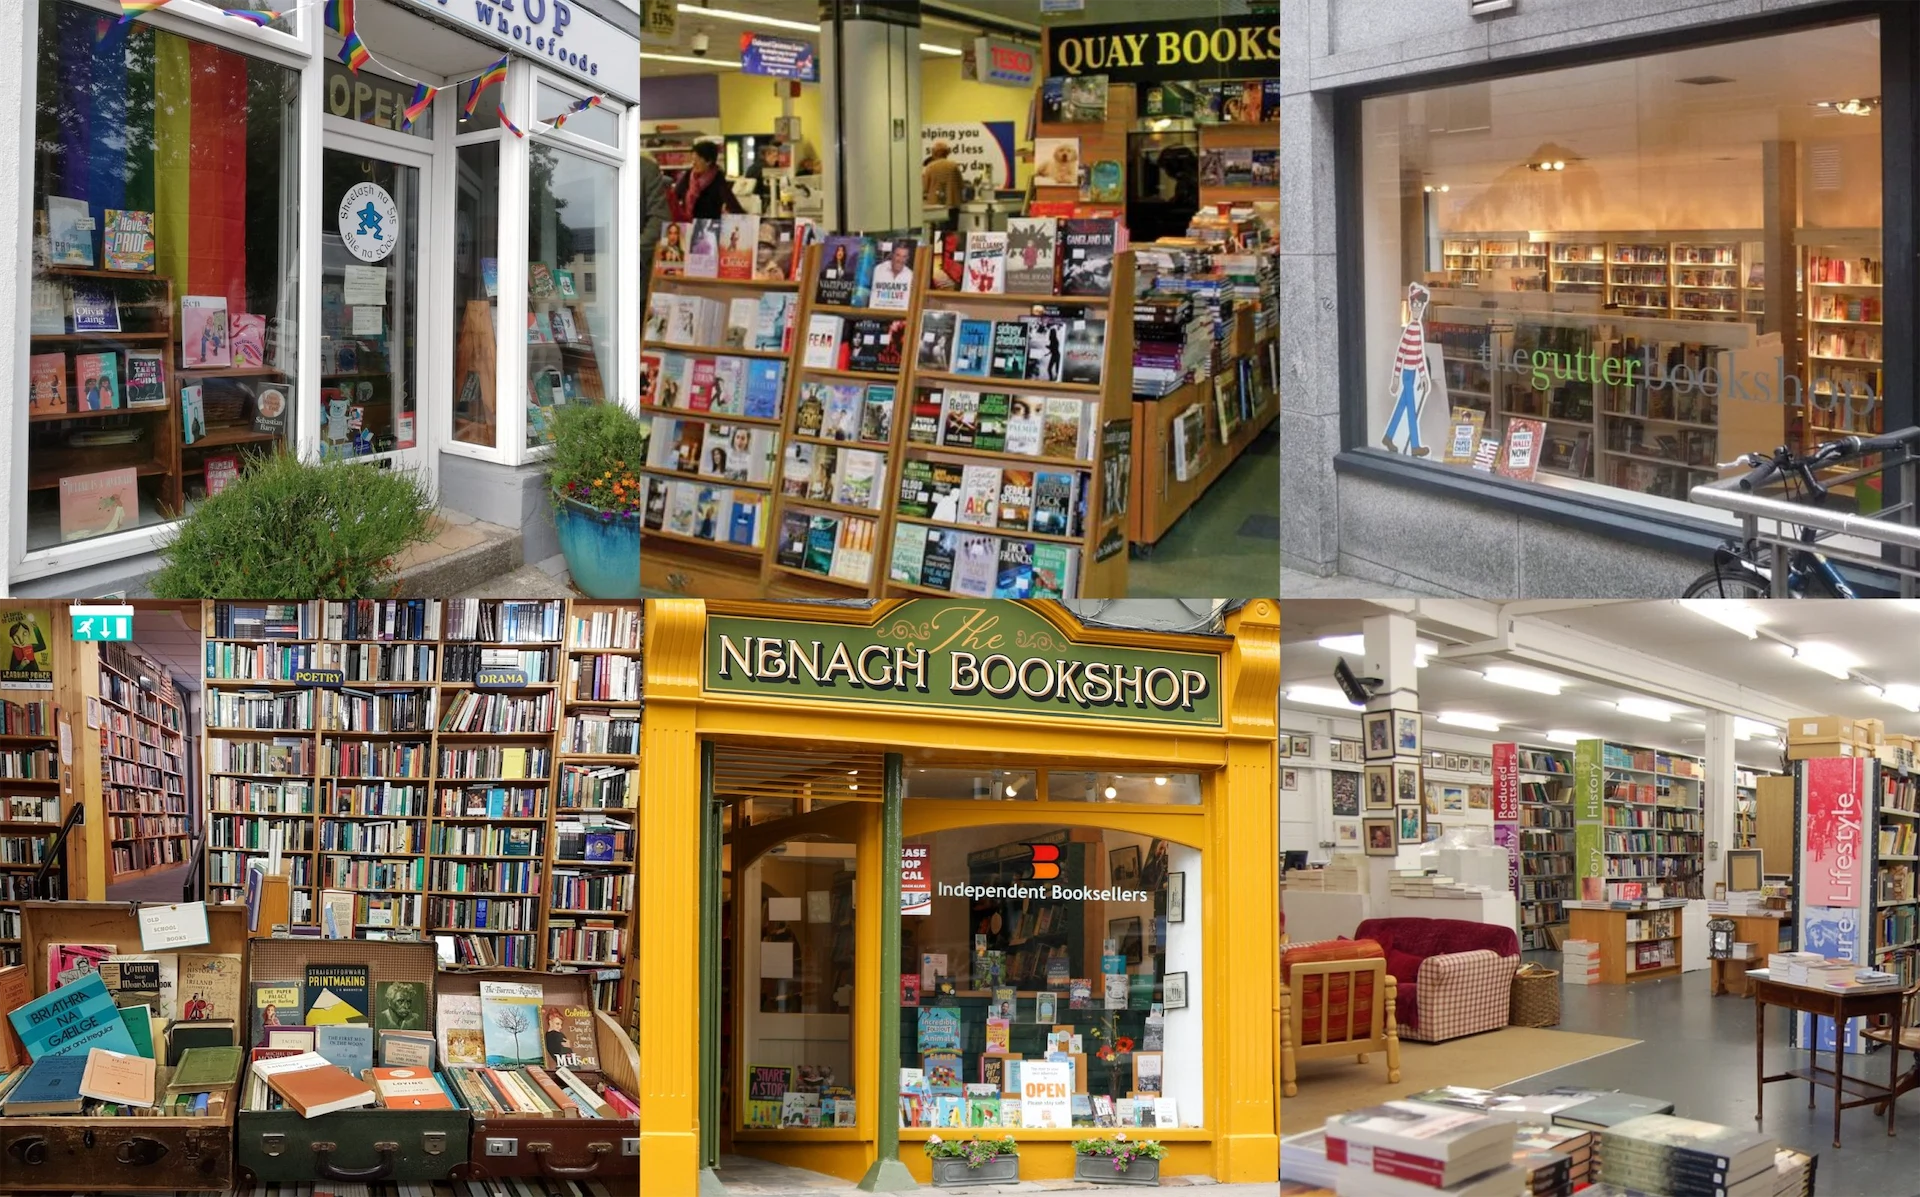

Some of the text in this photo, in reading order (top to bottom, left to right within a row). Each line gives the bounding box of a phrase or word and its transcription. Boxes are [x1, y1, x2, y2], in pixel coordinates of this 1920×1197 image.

[475, 1, 598, 76] Wholefoods
[1058, 26, 1280, 74] QUAY BOOKS
[991, 45, 1033, 73] TESCO
[921, 127, 980, 141] elping you
[962, 144, 984, 154] less
[970, 161, 993, 172] day
[377, 191, 389, 204] na
[120, 217, 142, 231] Have
[114, 232, 148, 253] PRIDE
[970, 242, 1004, 250] WILLIAMS
[1066, 233, 1112, 246] GANGLAND UK
[361, 249, 373, 259] na
[875, 282, 908, 291] WOGAN'S
[876, 291, 904, 300] TWELVE
[76, 306, 104, 316] Olivia
[77, 315, 105, 325] Laing
[996, 324, 1023, 336] sidney
[808, 333, 833, 347] FEAR
[996, 335, 1026, 347] sheldon
[949, 398, 979, 412] Reichs
[255, 416, 283, 427] Sebastian
[260, 423, 276, 432] Barry
[910, 424, 937, 433] JAMES
[901, 489, 916, 499] TEST
[1003, 484, 1031, 496] GERALD
[1001, 493, 1031, 506] SEYMOUR
[1036, 494, 1060, 507] JACK
[965, 497, 993, 516] ABC
[1007, 542, 1027, 553] DICK
[1000, 551, 1033, 564] FRANCIS
[908, 607, 1005, 655] The
[295, 672, 341, 684] POETRY
[479, 673, 524, 684] DRAMA
[718, 634, 1209, 710] NENAGH BOOKSHOP
[1498, 766, 1507, 819] Reduced
[1508, 753, 1517, 819] Bestsellers
[1587, 762, 1602, 818] History
[901, 848, 927, 858] EASE
[1829, 792, 1861, 902] Lifestyle
[901, 860, 921, 869] OP
[1507, 830, 1519, 892] iography
[1590, 847, 1602, 878] tory
[901, 871, 924, 880] CAL
[937, 881, 1148, 902] Independent Booksellers
[153, 925, 177, 933] SCHOOL
[308, 976, 366, 987] PRINTMAKING
[485, 983, 540, 998] The Burren Region
[30, 991, 91, 1024] BRIATHRA
[56, 1010, 80, 1028] NA
[48, 1015, 100, 1047] GAEILGE
[73, 1036, 88, 1048] and
[87, 1025, 114, 1041] Irregular
[554, 1052, 596, 1067] Mitsou
[756, 1068, 785, 1083] SHARE
[751, 1083, 789, 1096] A STORY
[1025, 1082, 1066, 1098] OPEN
